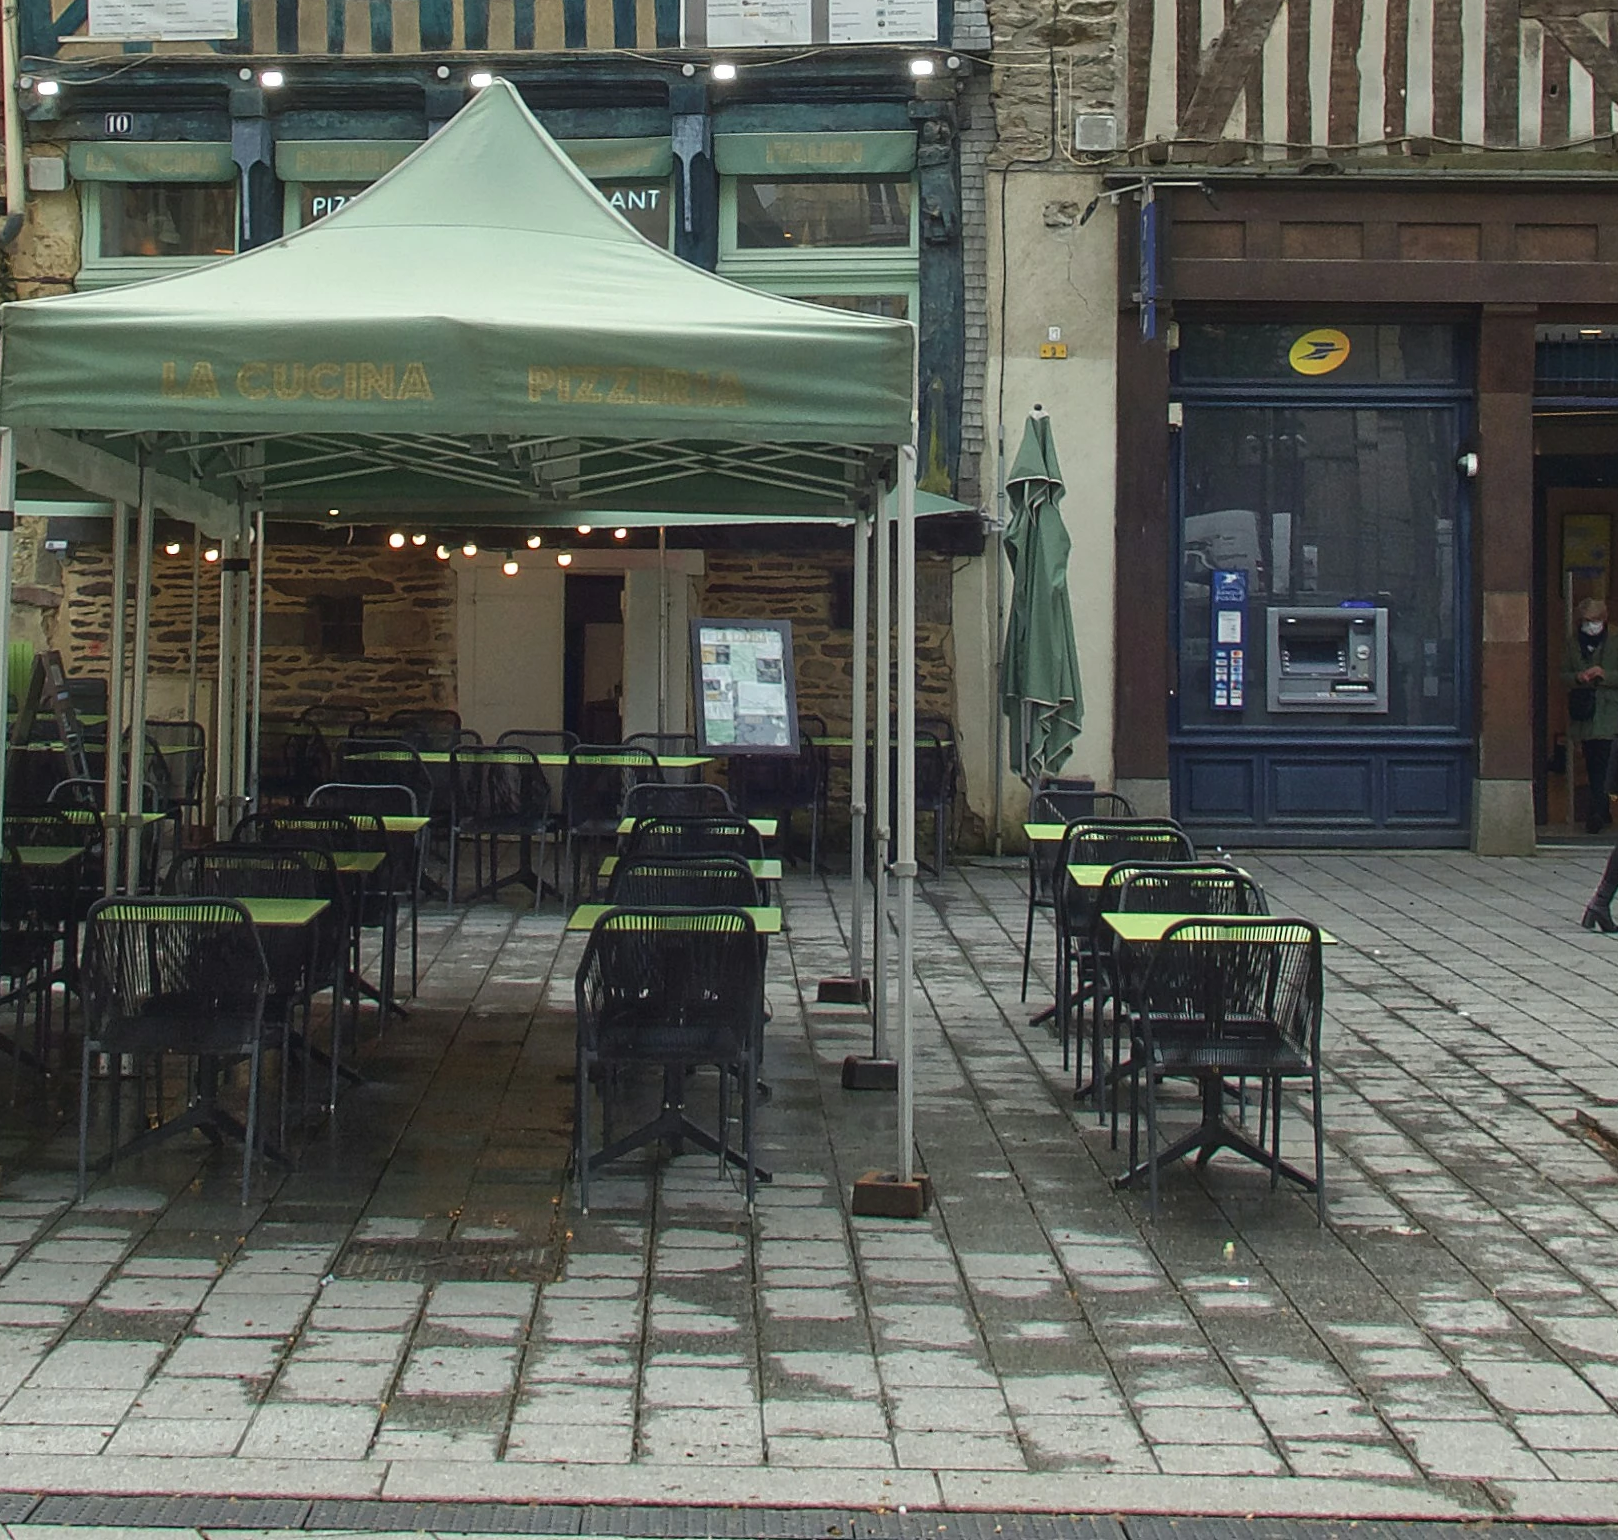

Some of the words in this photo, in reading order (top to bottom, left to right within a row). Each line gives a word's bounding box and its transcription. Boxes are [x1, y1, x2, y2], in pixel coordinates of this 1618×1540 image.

[108, 116, 129, 133] 10
[85, 151, 117, 173] LA
[160, 360, 222, 400] LA
[236, 360, 435, 401] CUCINA
[527, 363, 748, 408] PIZZERIA
